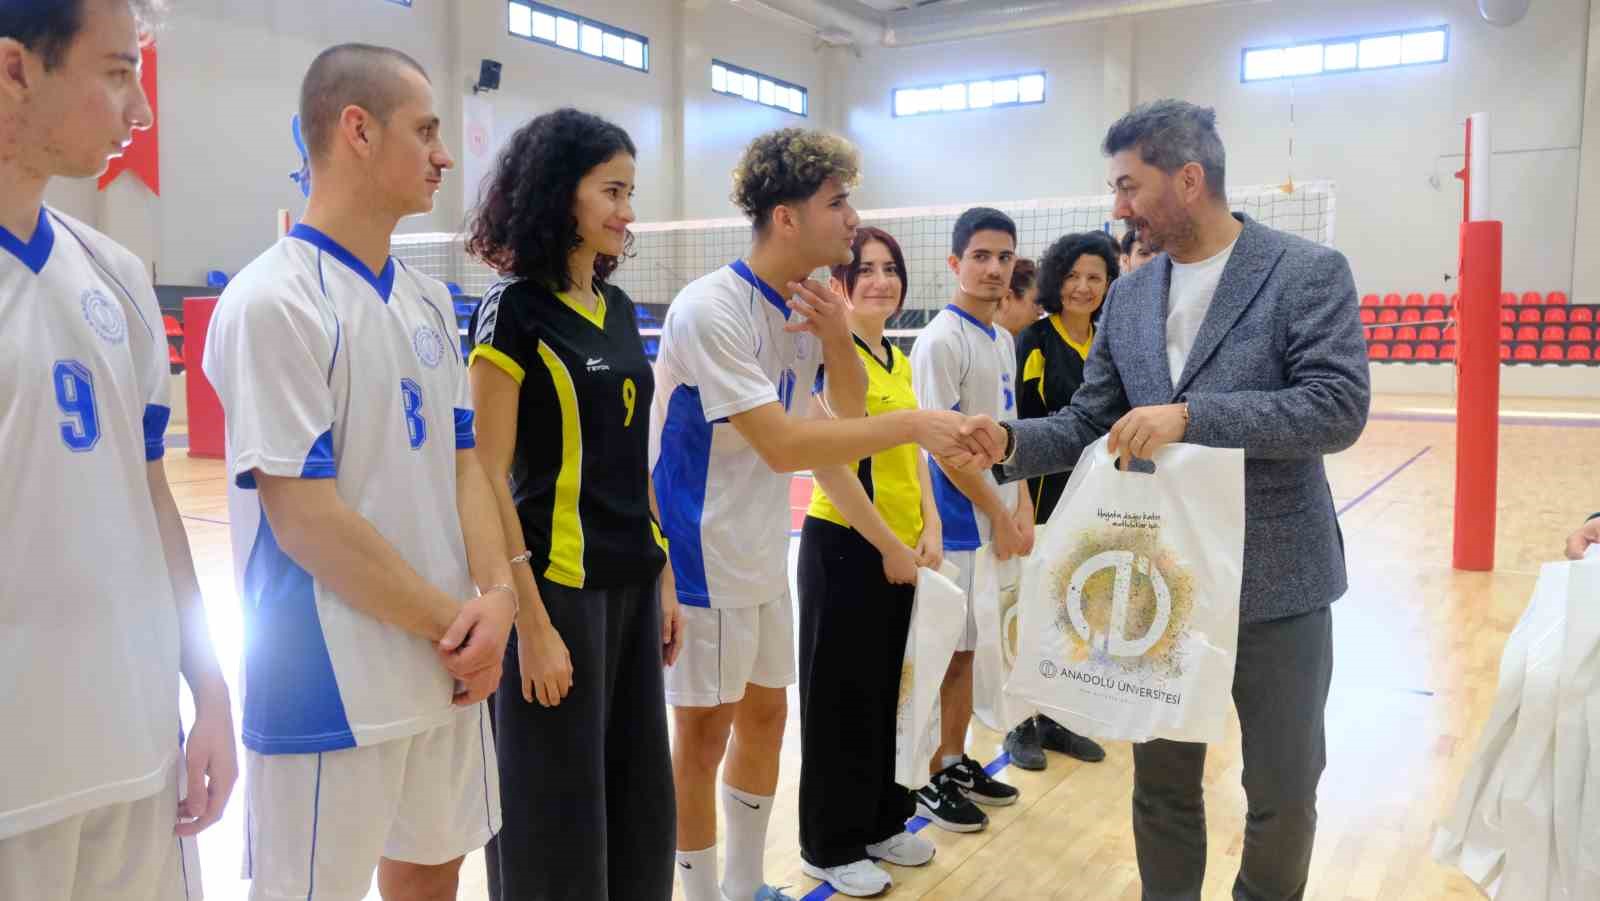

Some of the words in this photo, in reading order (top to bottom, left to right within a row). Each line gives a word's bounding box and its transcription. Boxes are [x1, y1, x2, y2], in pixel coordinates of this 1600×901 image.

[53, 359, 101, 452] 9
[622, 378, 637, 427] 9
[1060, 667, 1115, 689] ANADOLU
[1117, 680, 1182, 705] ÜNVERSİTESİ
